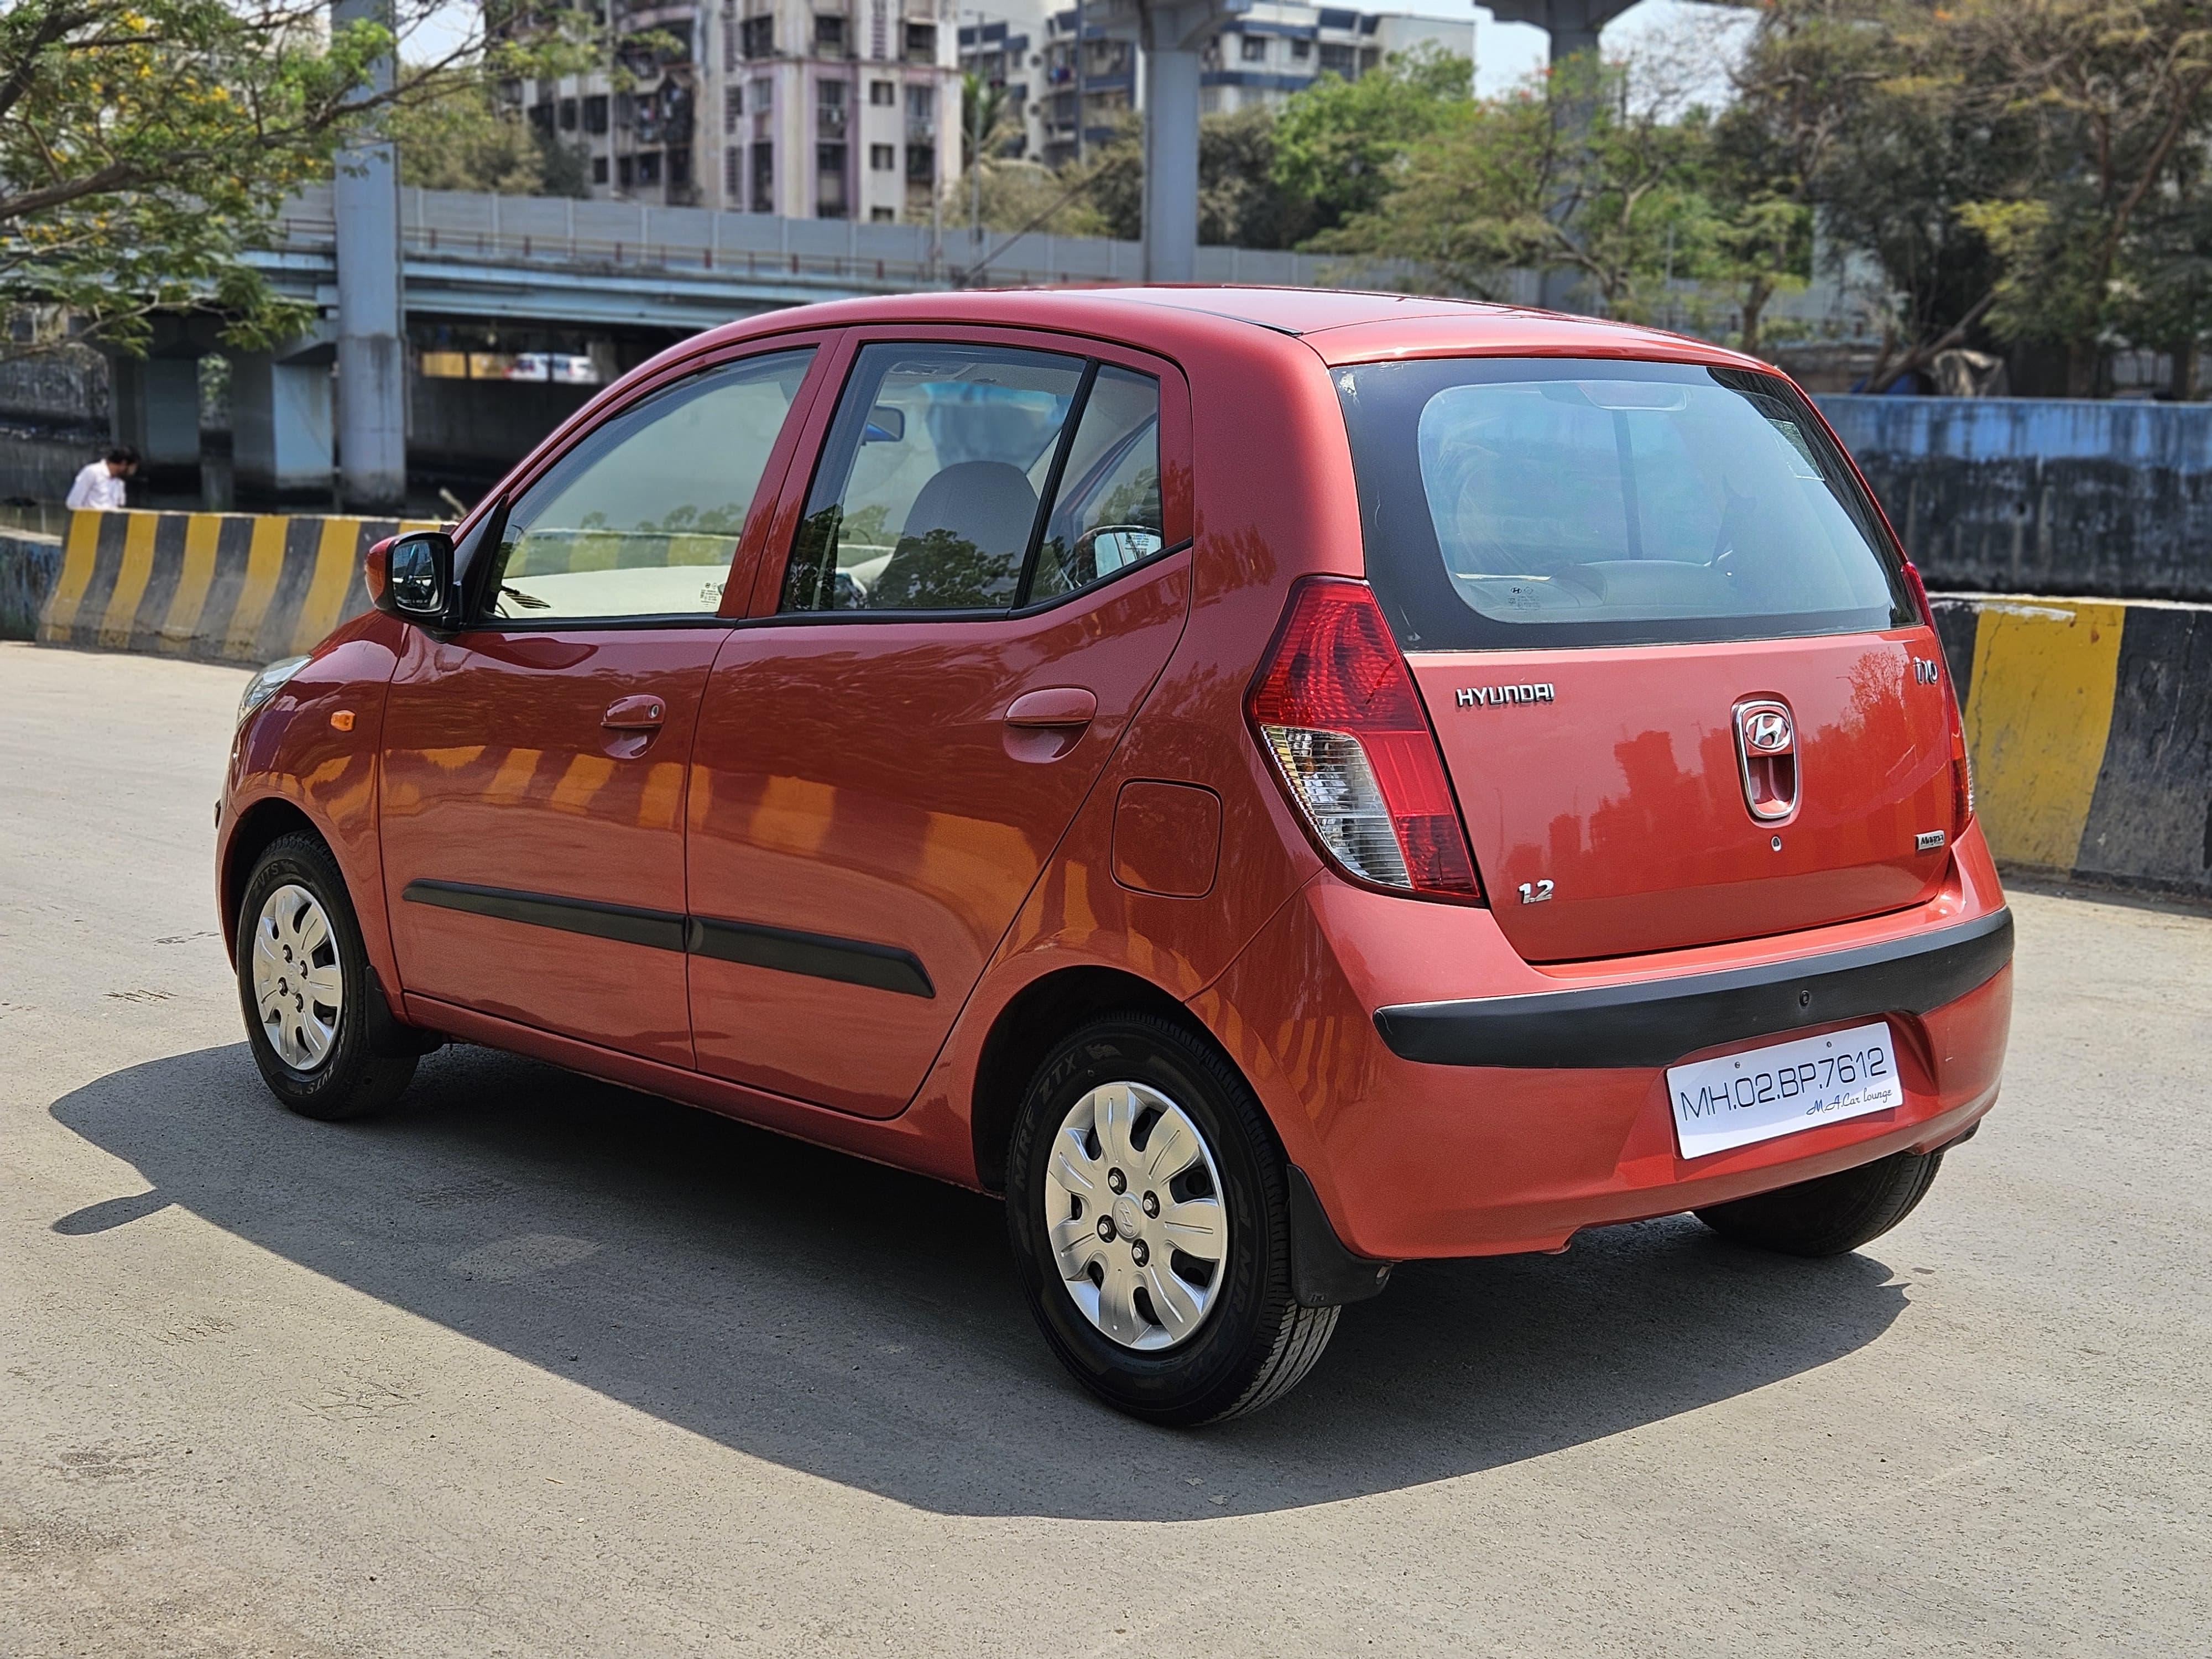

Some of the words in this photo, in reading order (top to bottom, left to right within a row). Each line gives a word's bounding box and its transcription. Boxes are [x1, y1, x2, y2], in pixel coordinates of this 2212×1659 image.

[1913, 656, 1938, 685] i10
[1456, 683, 1554, 706] HYUNDAI
[1518, 879, 1554, 904] 1.2
[1679, 1047, 1887, 1121] MH.02.BP.7612
